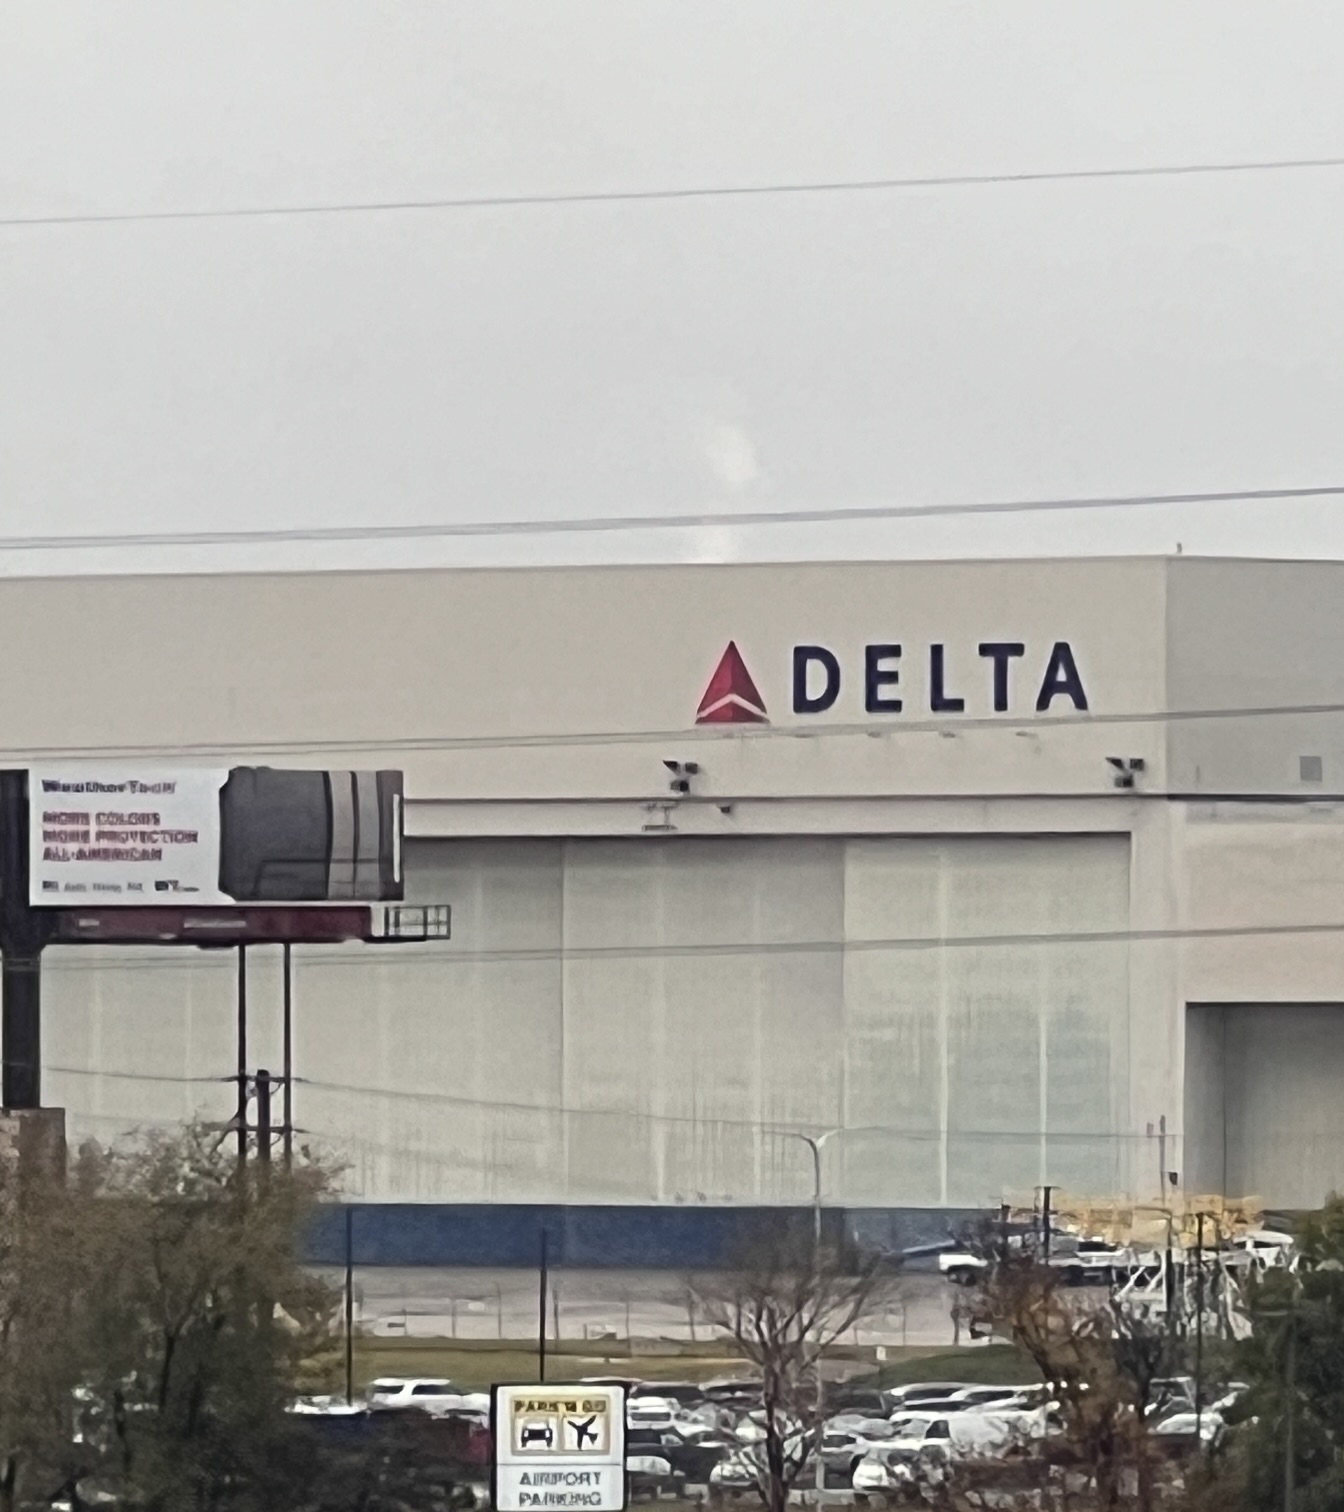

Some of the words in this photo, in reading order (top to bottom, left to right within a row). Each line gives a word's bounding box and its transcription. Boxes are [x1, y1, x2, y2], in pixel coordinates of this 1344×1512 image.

[792, 641, 1089, 714] DELTA
[95, 811, 161, 826] COLORS
[95, 830, 198, 844] PROTECTION
[519, 1471, 602, 1486] AIRPORT
[519, 1491, 602, 1507] PARKING
